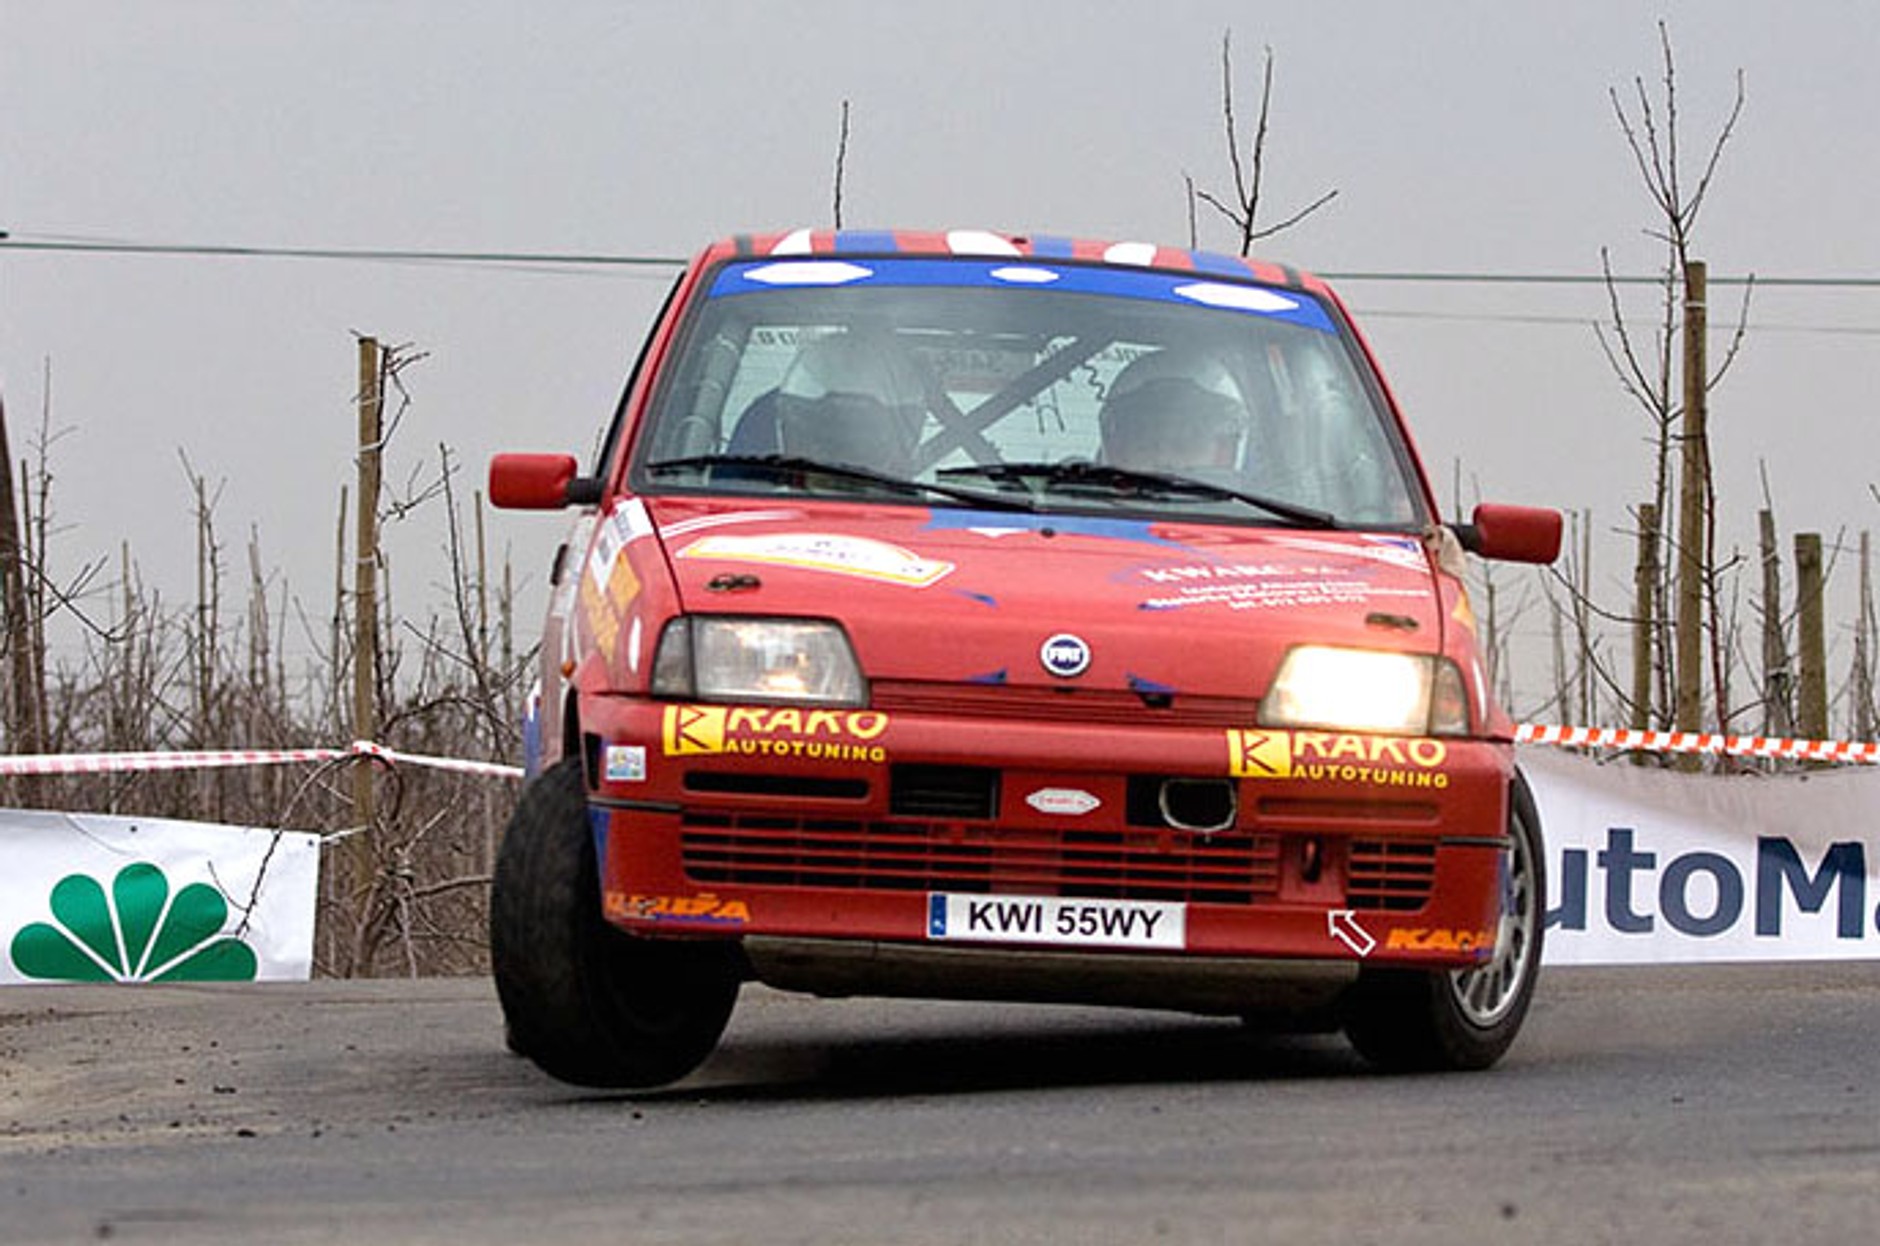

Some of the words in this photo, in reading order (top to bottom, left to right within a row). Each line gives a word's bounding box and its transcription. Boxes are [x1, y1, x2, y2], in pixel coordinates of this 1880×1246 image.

[726, 738, 886, 762] AUTOTUNING
[1292, 764, 1449, 789] AUTOTUNING
[1544, 828, 1880, 938] utoM
[969, 901, 1043, 933] KWI
[1056, 905, 1163, 939] 55WY
